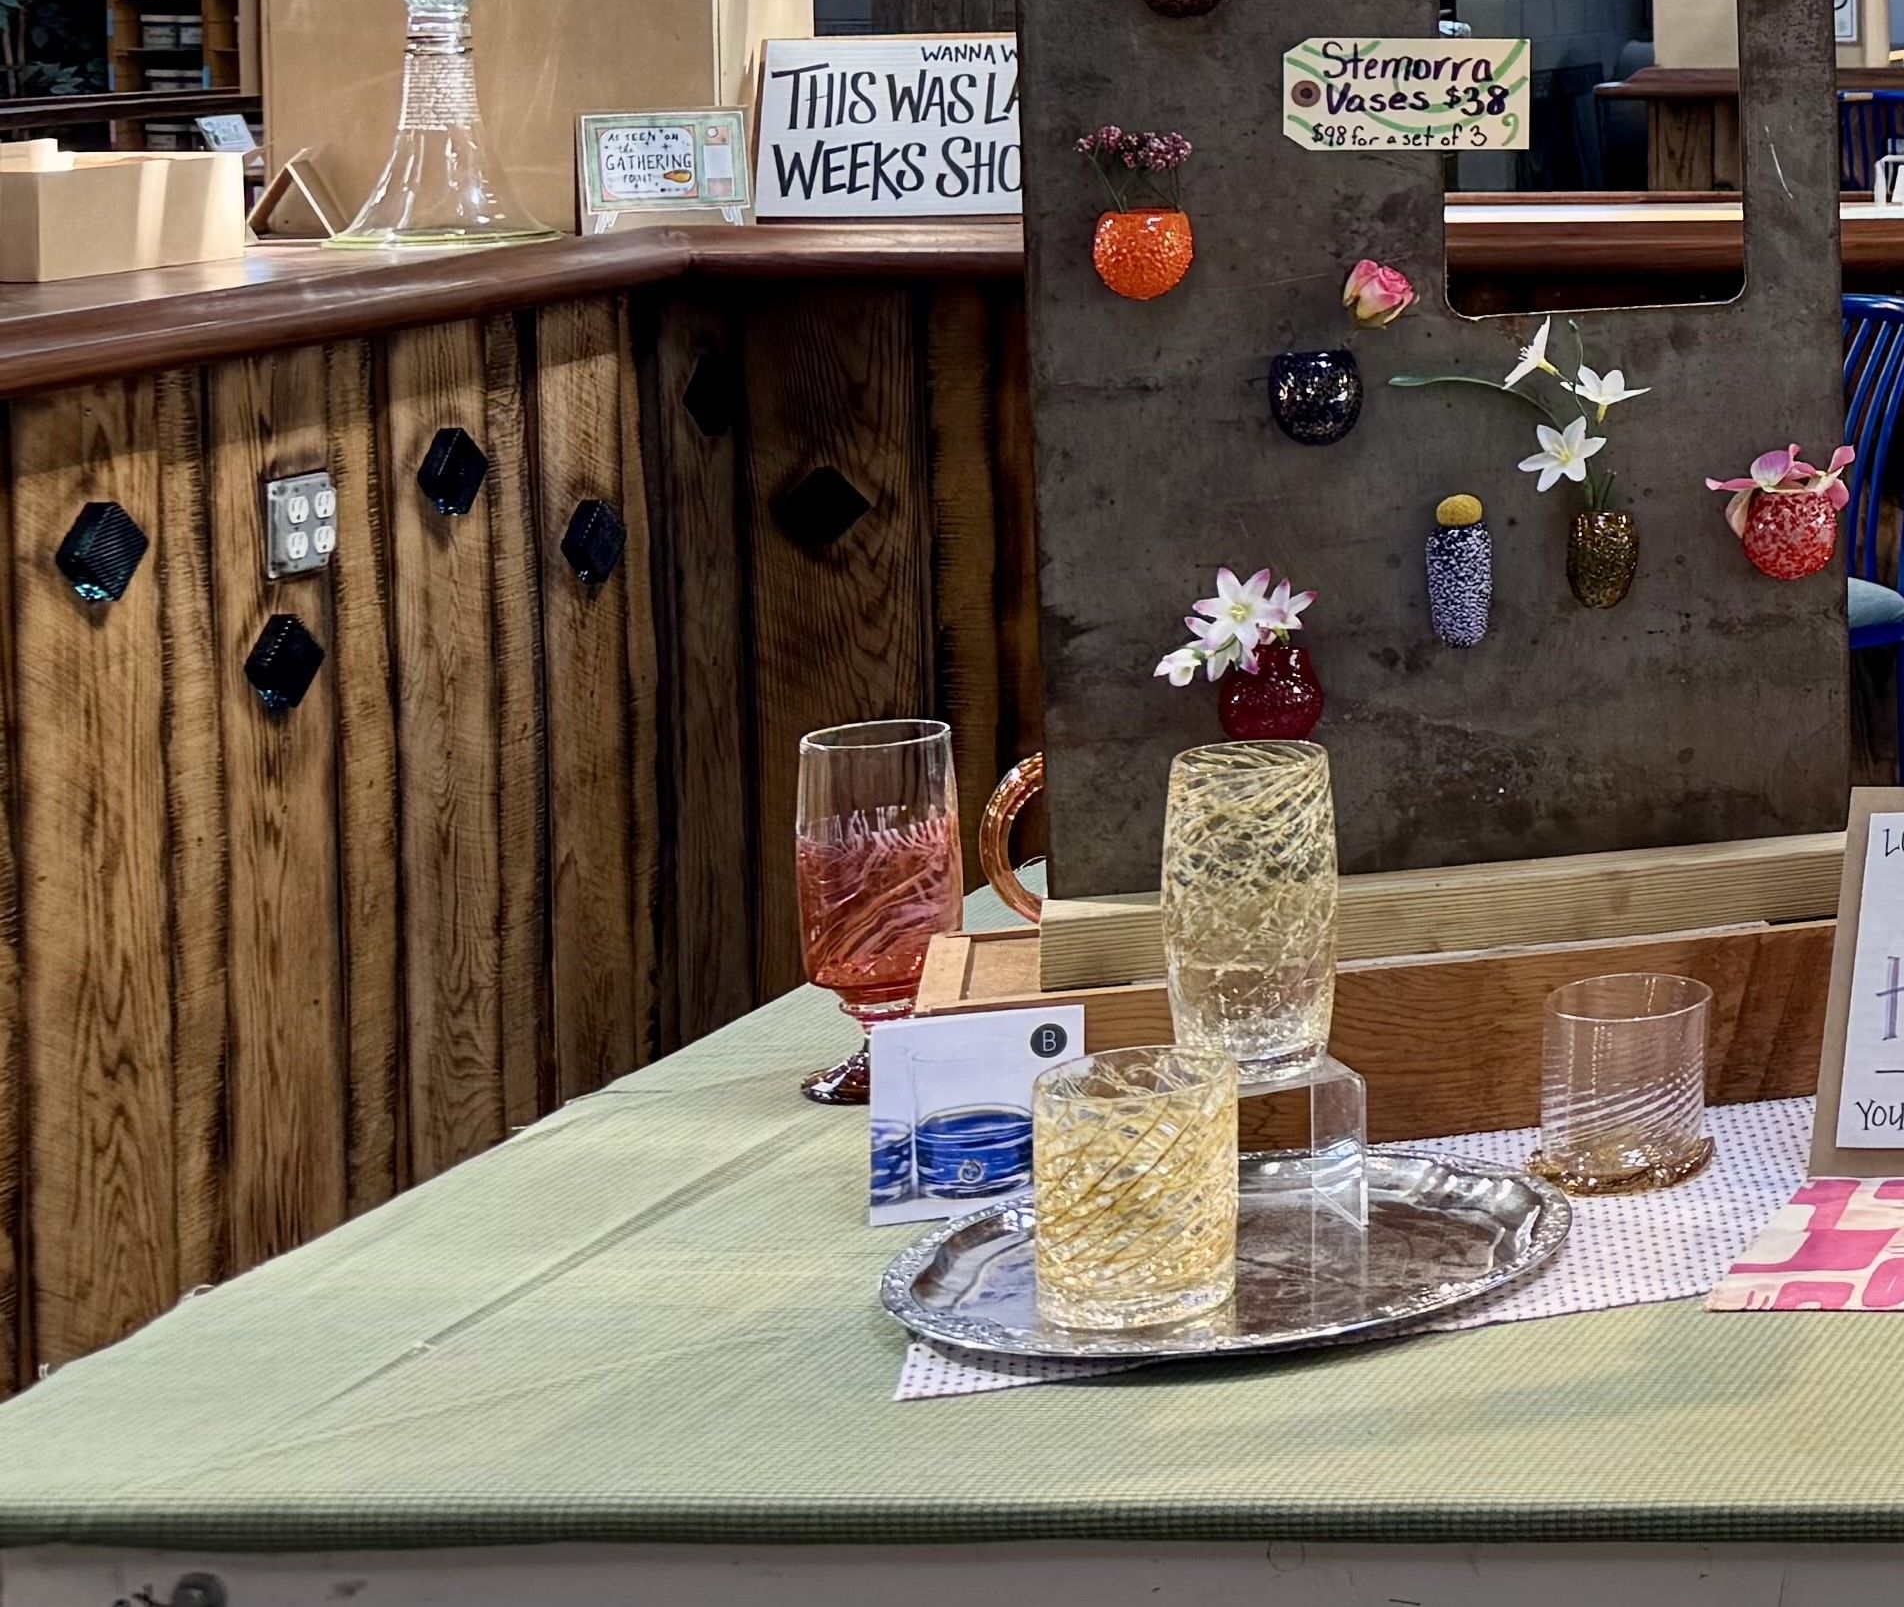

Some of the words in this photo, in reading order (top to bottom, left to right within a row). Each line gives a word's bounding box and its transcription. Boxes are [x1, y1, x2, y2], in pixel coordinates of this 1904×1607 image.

[921, 44, 996, 64] WANNA
[1322, 42, 1493, 82] Stemorra
[772, 63, 876, 129] THIS
[886, 70, 976, 127] WAS
[1326, 87, 1430, 114] Vases
[1445, 85, 1509, 116] $38
[1311, 125, 1347, 148] $98
[1351, 128, 1379, 147] for
[1388, 135, 1396, 144] a
[1399, 129, 1435, 147] set
[1442, 127, 1465, 147] of
[1471, 127, 1486, 146] 3
[606, 154, 691, 170] GATHERING
[772, 140, 926, 200] WEEKS
[1042, 1030, 1056, 1051] B
